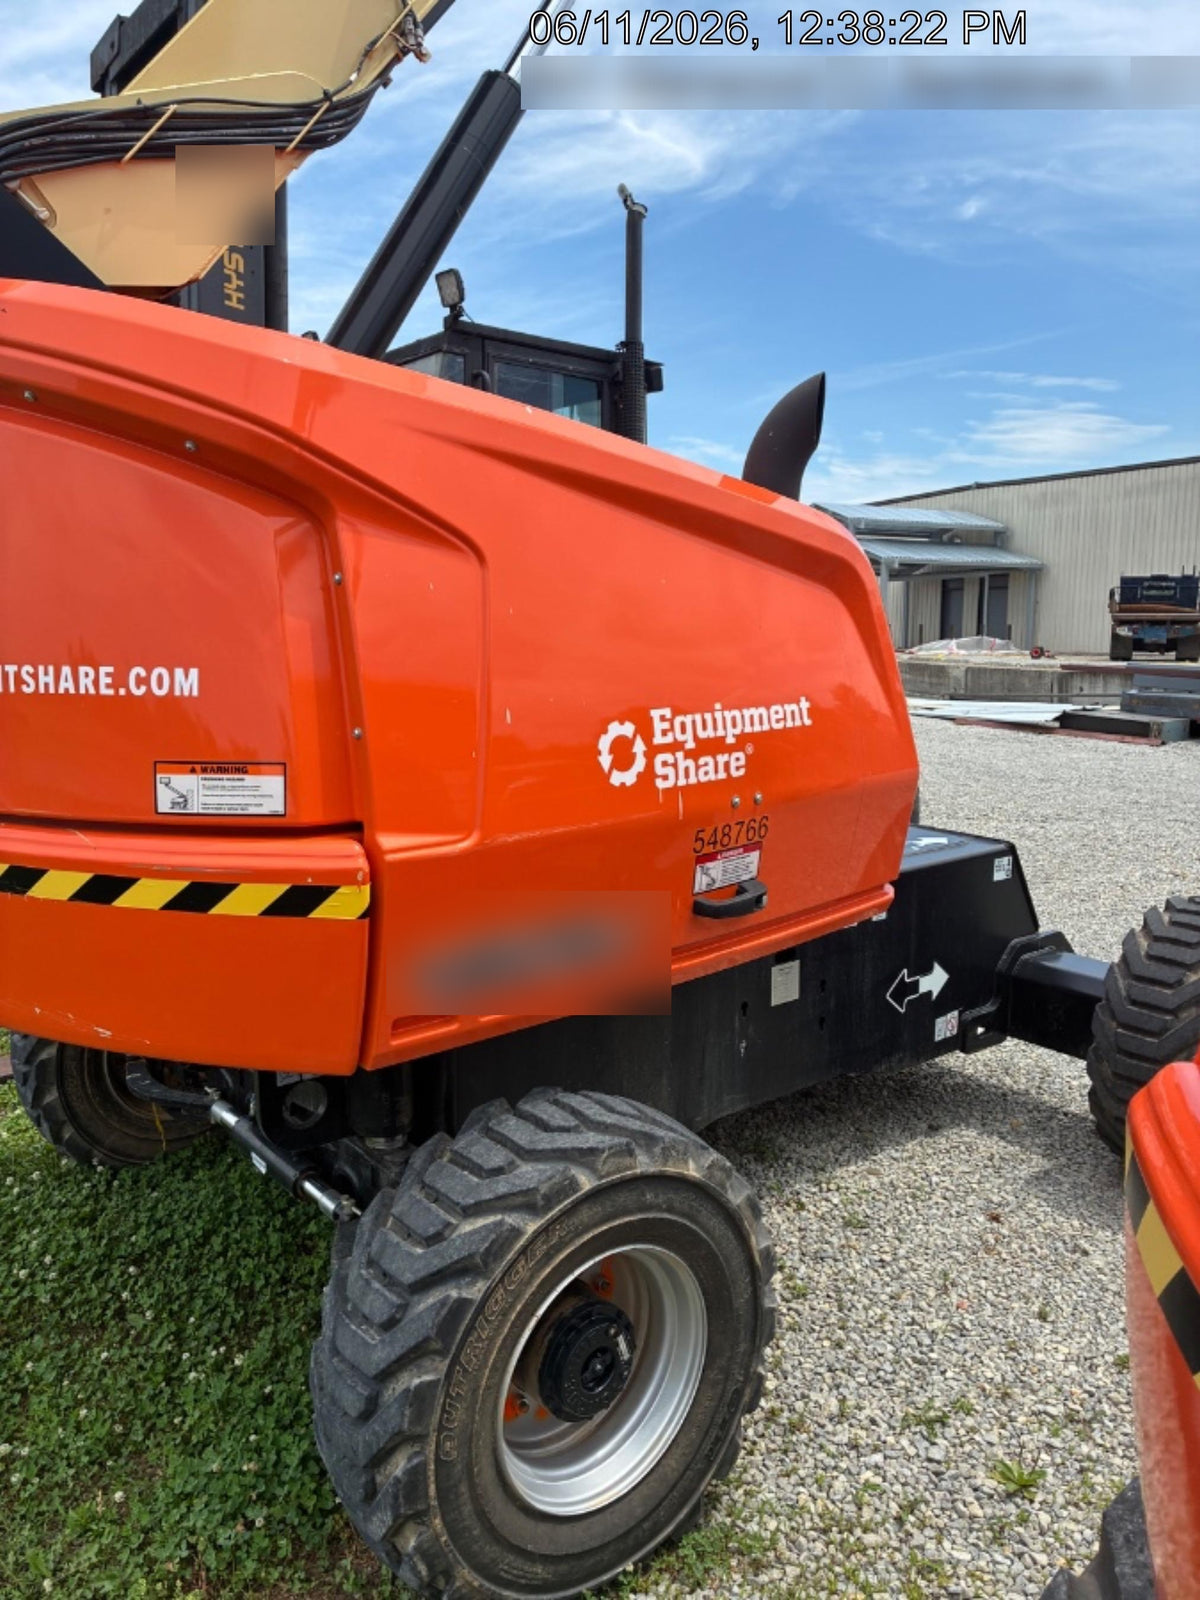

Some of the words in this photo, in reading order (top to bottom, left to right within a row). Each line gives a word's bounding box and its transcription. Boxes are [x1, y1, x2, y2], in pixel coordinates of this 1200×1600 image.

[223, 245, 245, 310] HYS
[0, 664, 199, 697] TSHARE.COM
[650, 696, 812, 750] Equipment
[200, 765, 248, 774] WARNING
[653, 750, 747, 790] Share
[693, 815, 769, 854] 548766
